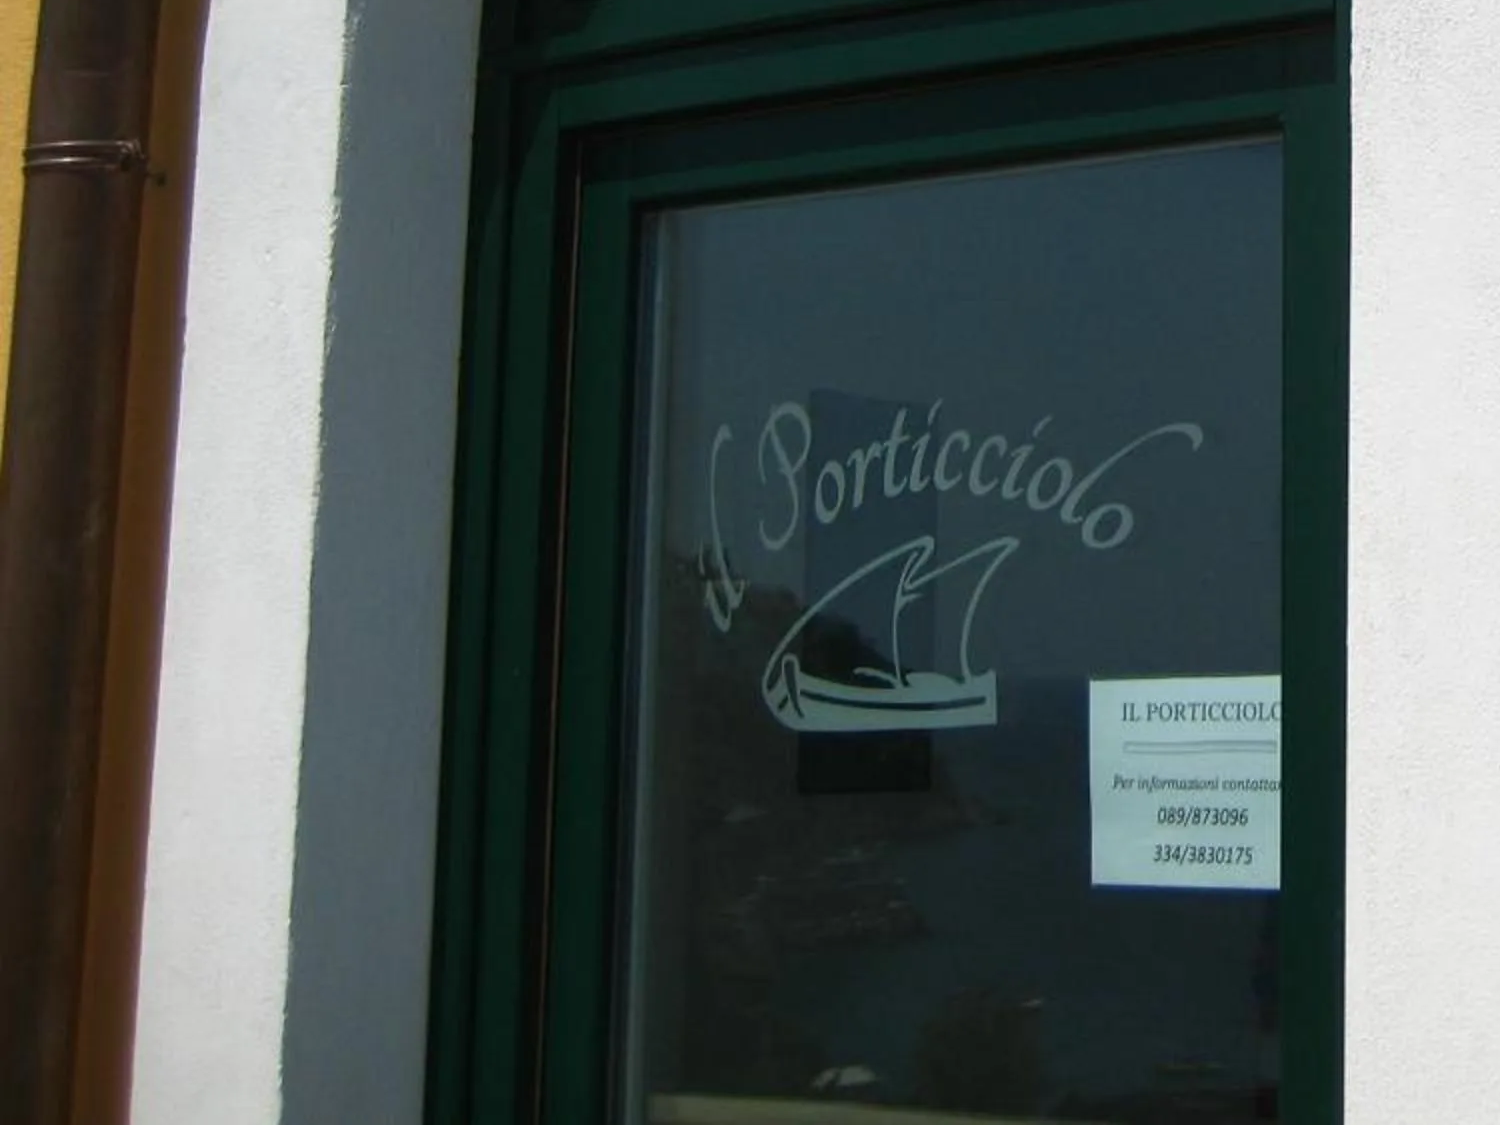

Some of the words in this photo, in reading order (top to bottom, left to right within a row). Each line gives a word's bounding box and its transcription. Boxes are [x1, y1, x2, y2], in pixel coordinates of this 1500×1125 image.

[757, 398, 1204, 550] Porticciolo
[1122, 702, 1141, 722] IL
[1113, 774, 1135, 791] Per
[1138, 775, 1219, 793] informazioni
[1156, 806, 1249, 827] 089/873096
[1153, 844, 1254, 865] 334/3830175
